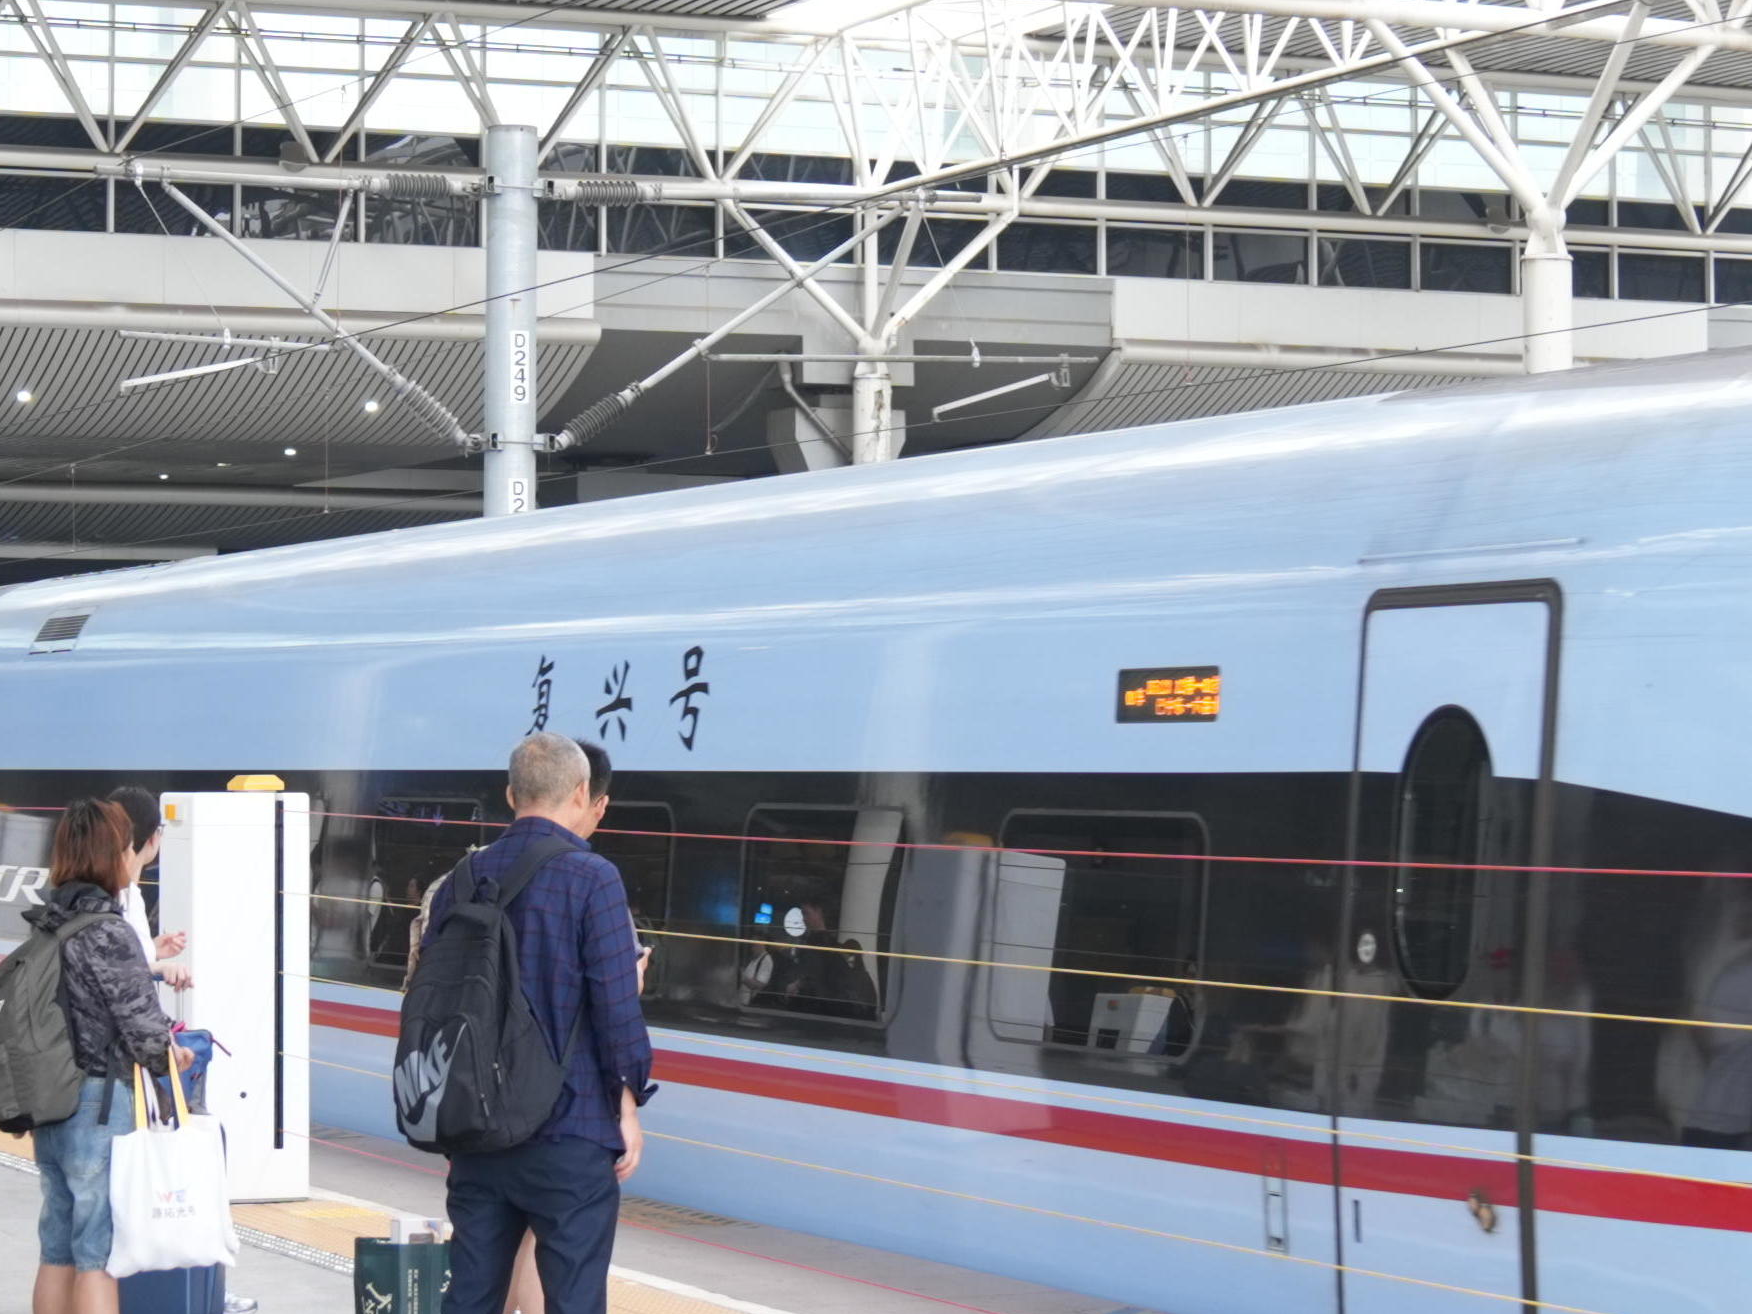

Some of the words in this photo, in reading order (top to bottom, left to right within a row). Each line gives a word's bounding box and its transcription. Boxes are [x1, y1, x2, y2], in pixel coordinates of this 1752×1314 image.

[514, 333, 526, 401] D249
[524, 645, 710, 752] 复兴号
[394, 1028, 448, 1117] NIKE
